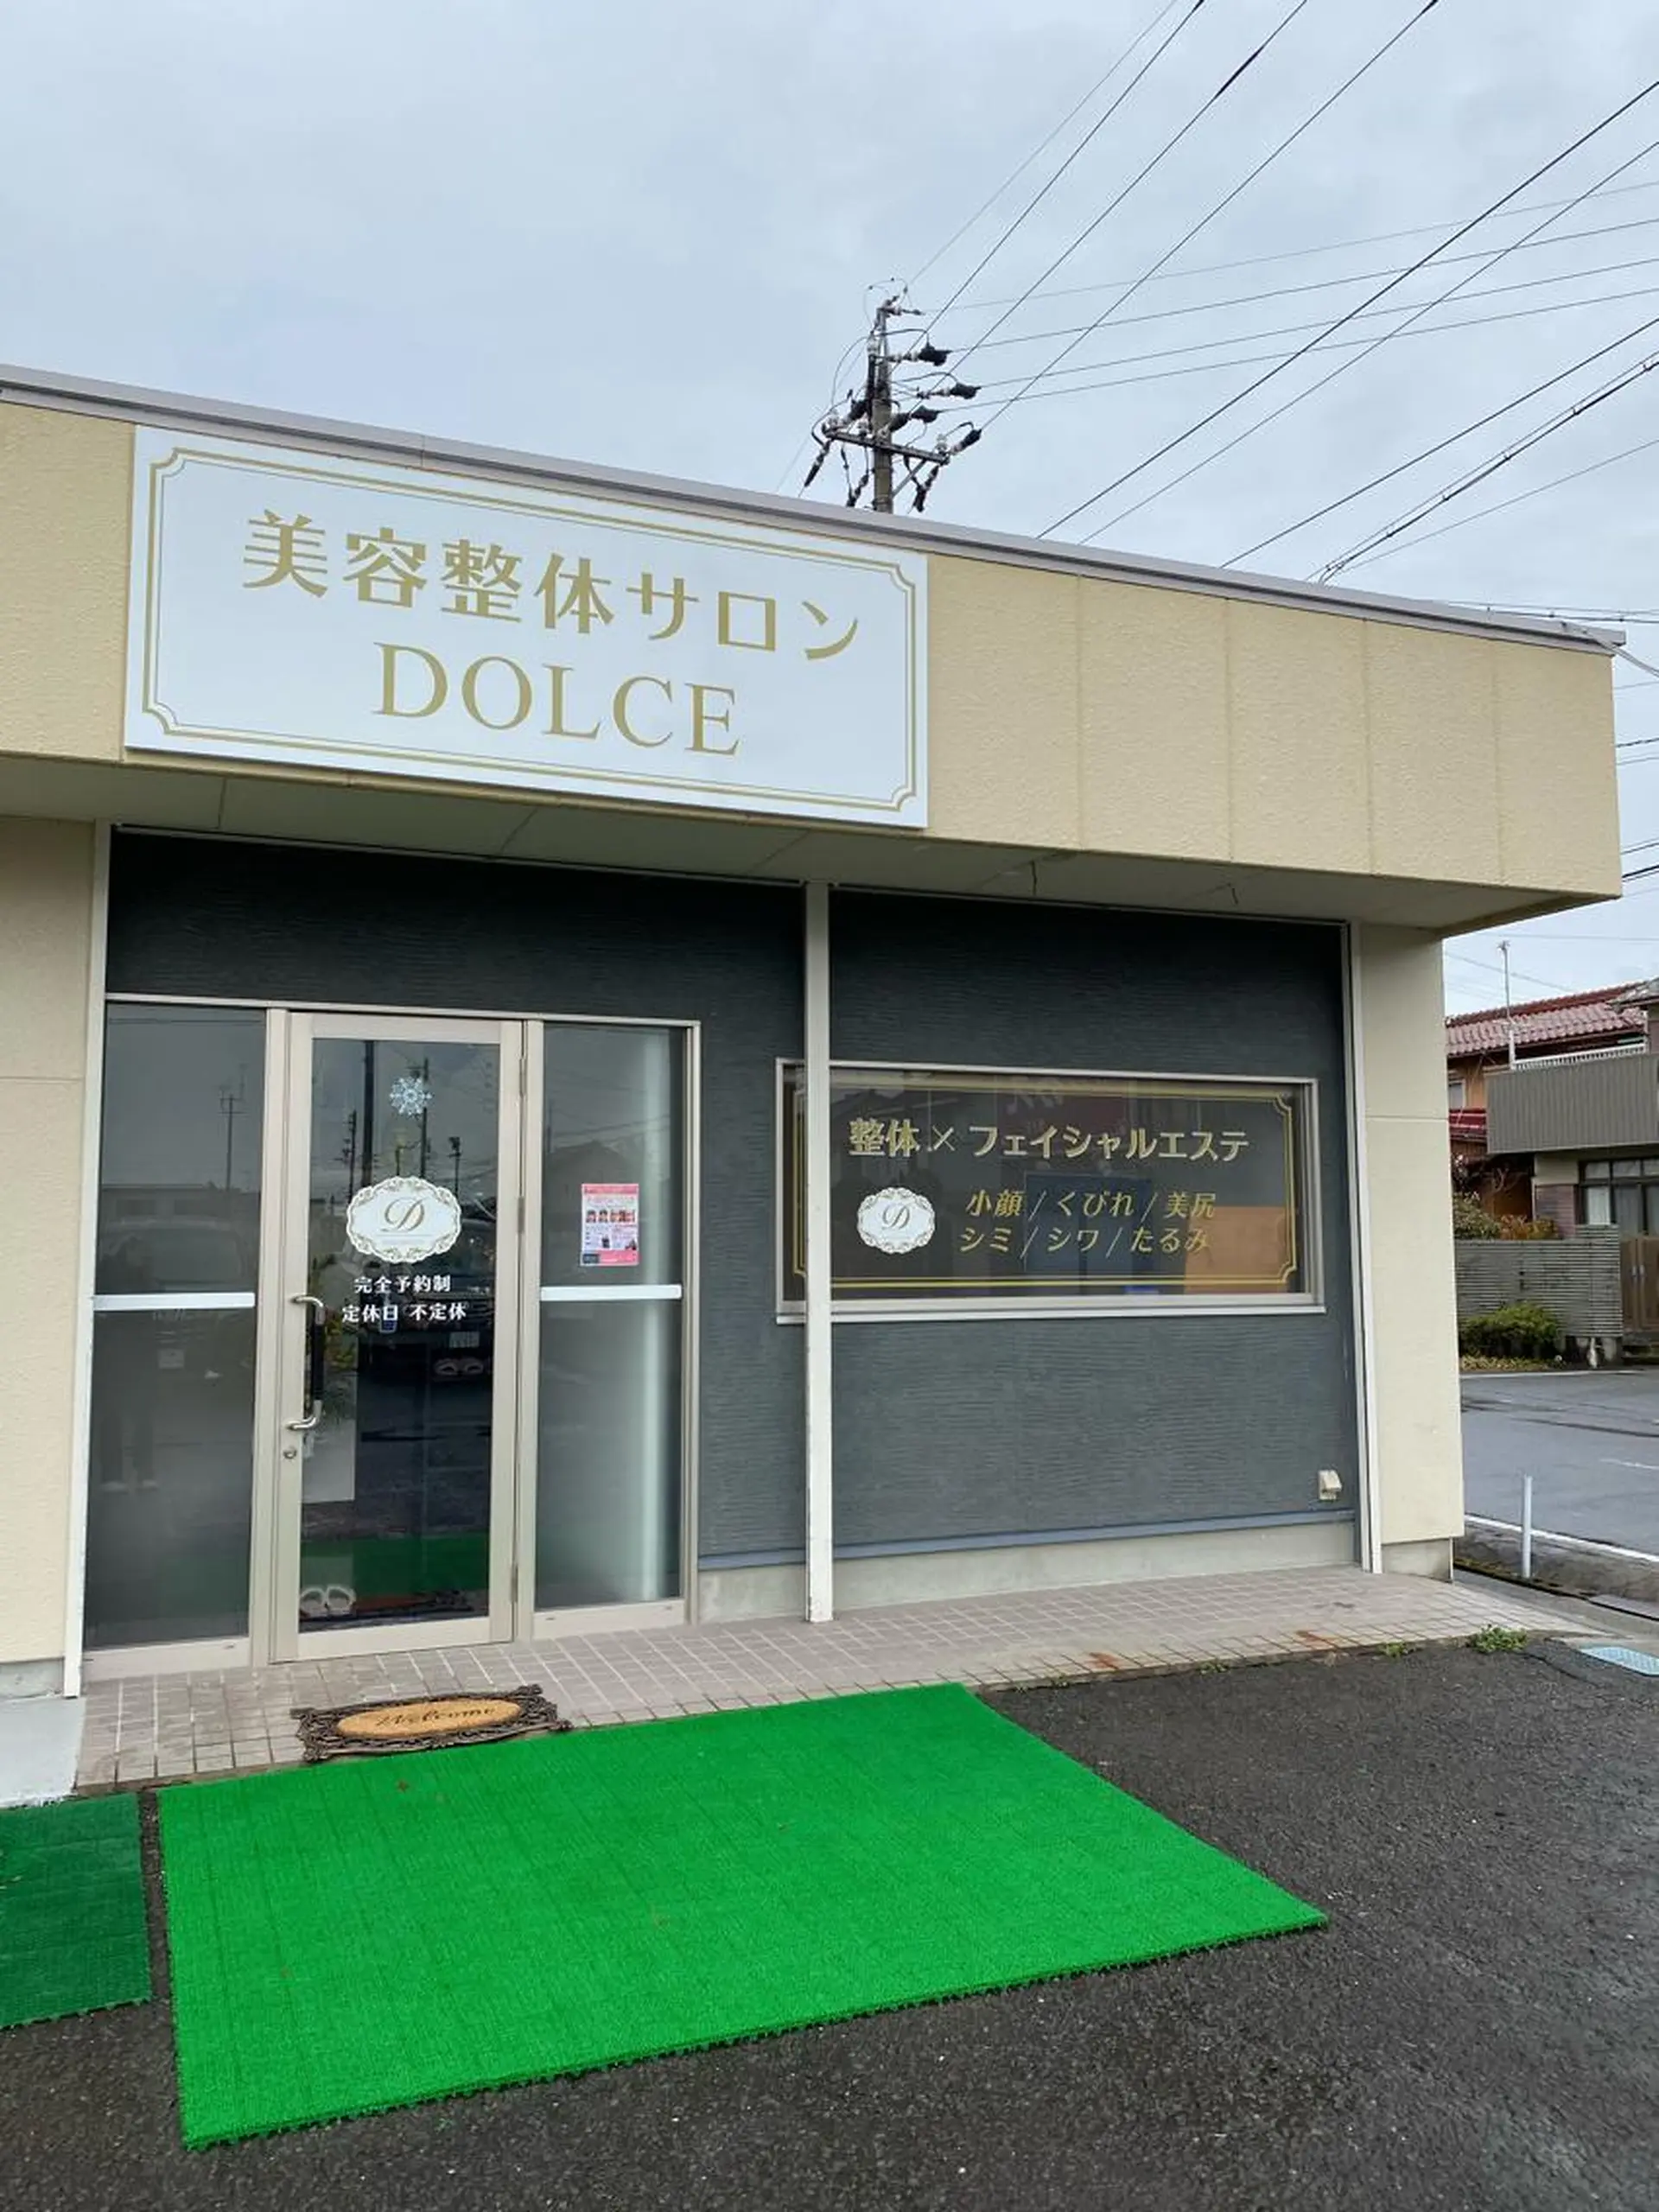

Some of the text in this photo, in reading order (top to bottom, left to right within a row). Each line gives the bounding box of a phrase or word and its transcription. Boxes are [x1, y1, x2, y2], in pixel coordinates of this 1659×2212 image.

[242, 508, 859, 661] 美容整体サロン
[372, 642, 741, 756] DOLCE
[340, 1301, 467, 1324] 定休日 不定休
[353, 1274, 452, 1295] 完全予約制
